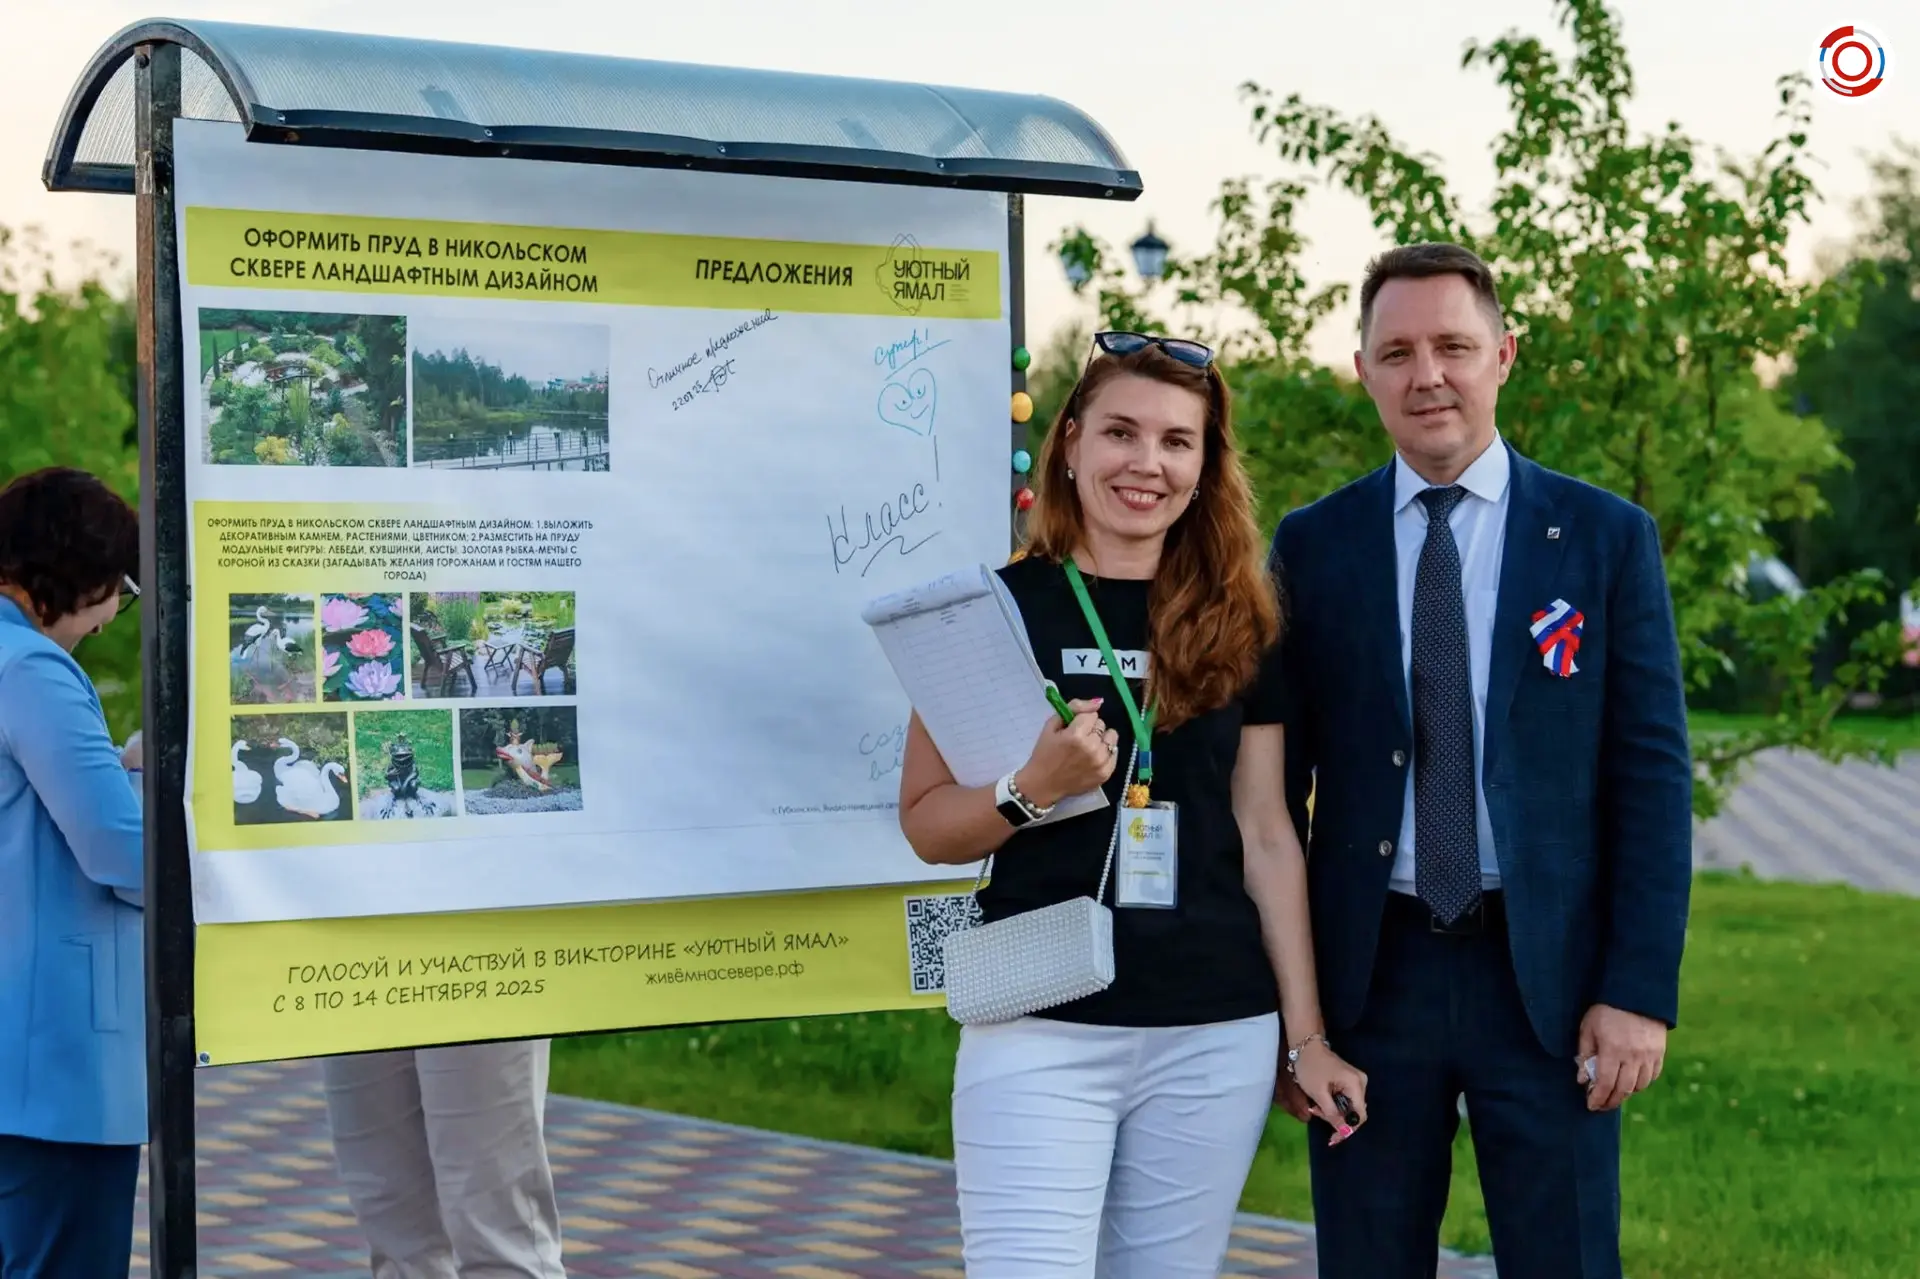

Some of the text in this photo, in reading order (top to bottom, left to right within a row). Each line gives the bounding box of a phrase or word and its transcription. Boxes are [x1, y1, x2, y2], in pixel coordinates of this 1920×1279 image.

[244, 228, 587, 263] ОФОРМИТЬ ПРУД В НИКОЛЬСКОМ
[230, 257, 598, 292] СКВЕРЕ ЛАНДШАФТНЫМ ДИЗАЙНОМ
[695, 258, 853, 286] ПРЕДЛОЖЕНИЯ
[894, 258, 970, 280] УЮТНЫЙ
[893, 281, 945, 301] ЯМАЛ
[207, 518, 594, 530] ОФОРМИТЬ ПРУД В НИКОЛЬСКОМ СКВЕРЕ ЛАНДШАФТНЫМ ДИЗАЙНОМ: 1.ВЫЛОЖИТЬ
[219, 532, 297, 542] ДЕКОРАТИВНЫМ
[299, 532, 343, 542] КАМНЕМ,
[346, 532, 410, 542] РАСТЕНИЯМИ,
[471, 532, 534, 542] 2.РАЗМЕСТИТЬ
[536, 533, 548, 542] НА
[550, 533, 580, 543] ПРУДУ
[222, 545, 284, 555] МОДУЛЬНЫЕ
[286, 545, 326, 555] ФИГУРЫ:
[328, 545, 367, 555] ЛЕБЕДИ,
[369, 545, 423, 555] КУВШИНКИ,
[463, 545, 503, 554] ЗОЛОТАЯ
[506, 545, 568, 554] РЫБКА-МЕЧТЫ
[570, 545, 577, 554] С
[218, 557, 582, 568] КОРОНОЙ ИЗ СКАЗКИ (ЗАГАДЫВАТЬ ЖЕЛАНИЯ ГОРОЖАНАМ И ГОСТЯМ НАШЕГО
[384, 571, 426, 581] ГОРОДА)
[288, 930, 849, 984] ГОЛОСУЙ И УЧАСТВУЙ В ВИКТОРИНЕ «УЮТНЫЙ ЯМАЛ»
[645, 960, 805, 985] живёмнасевере.рф
[273, 979, 546, 1013] С 8 ПО 14 СЕНТЯБРЯ 2025
